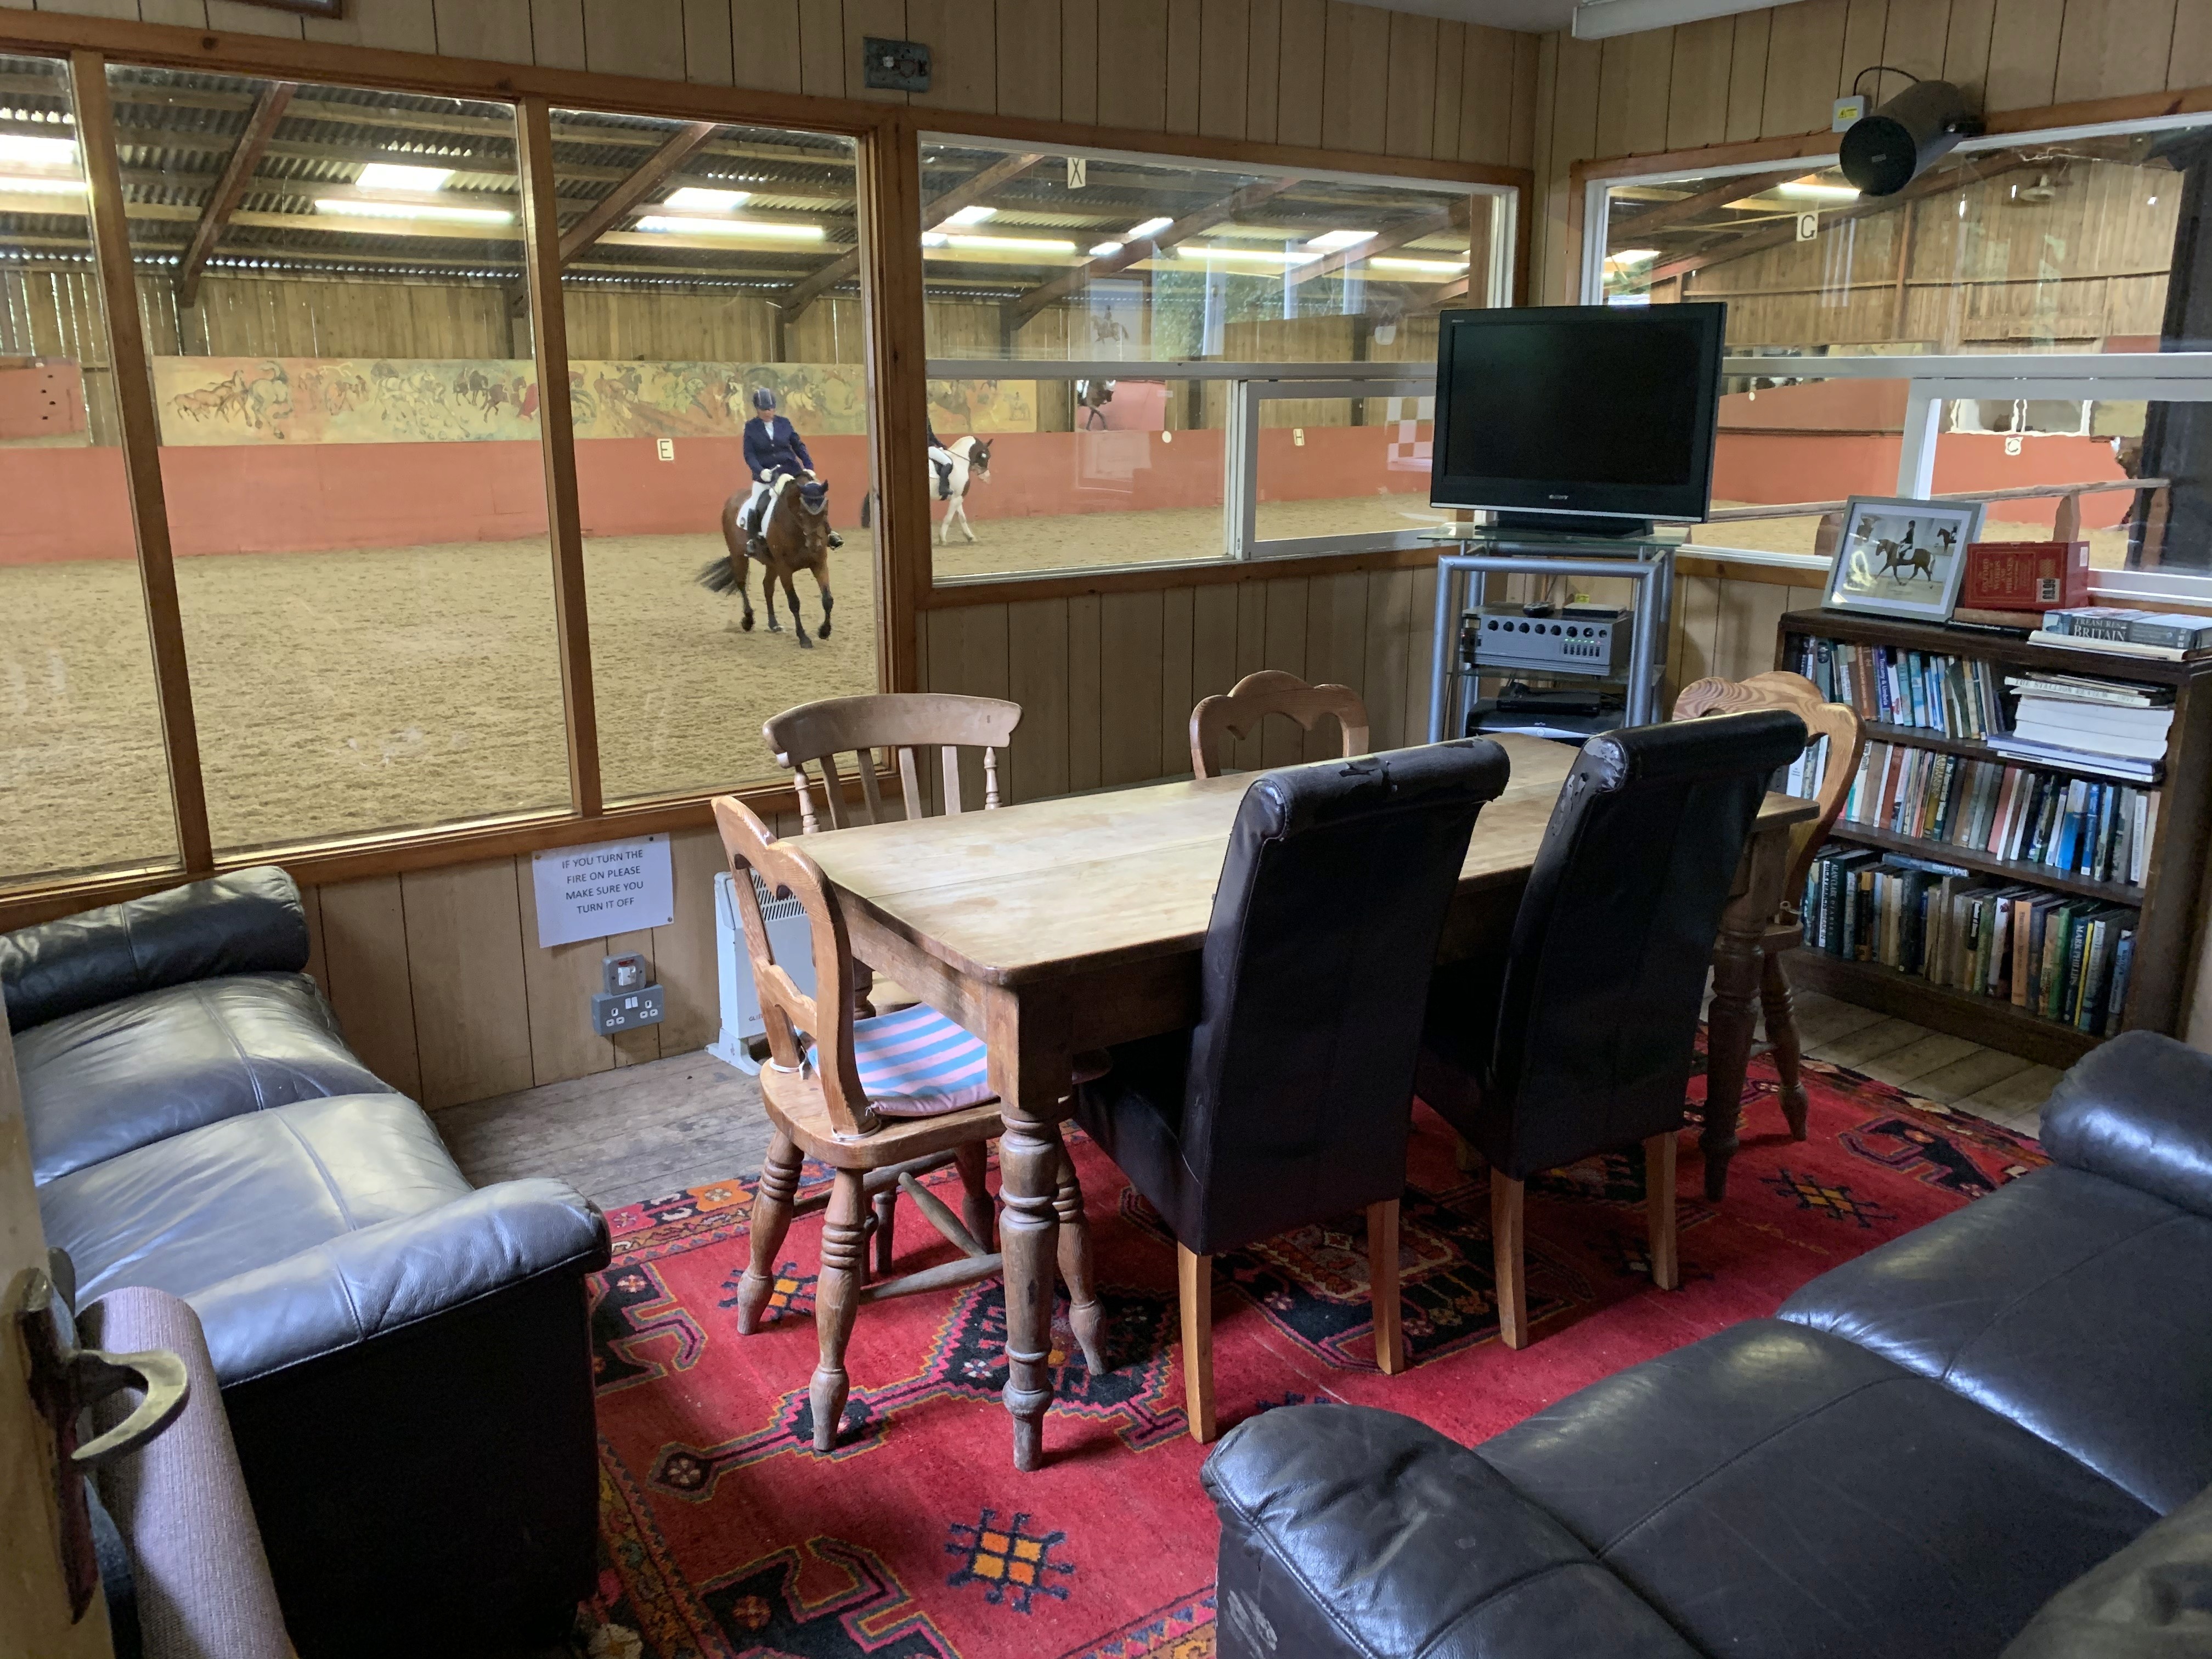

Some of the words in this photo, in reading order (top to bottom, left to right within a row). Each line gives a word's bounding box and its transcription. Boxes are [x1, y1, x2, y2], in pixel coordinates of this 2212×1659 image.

[1070, 158, 1082, 186] X
[1801, 215, 1815, 239] G
[1295, 430, 1304, 445] H
[2007, 439, 2020, 453] C
[660, 441, 672, 459] E
[2075, 618, 2121, 629] TREASURES
[2074, 625, 2126, 642] BRITAIN
[562, 860, 571, 869] IF
[573, 857, 594, 867] YOU
[596, 853, 623, 863] TURN
[625, 849, 643, 859] THE
[567, 873, 586, 884] FIRE
[589, 871, 605, 881] ON
[607, 865, 641, 878] PLEASE
[566, 888, 594, 900] MAKE
[596, 884, 620, 895] SURE
[623, 881, 644, 891] YOU
[576, 902, 603, 914] TURN
[606, 900, 614, 909] IT
[617, 897, 634, 907] OFF
[2075, 925, 2084, 950] MARK
[2069, 950, 2081, 985] PHILLIPS
